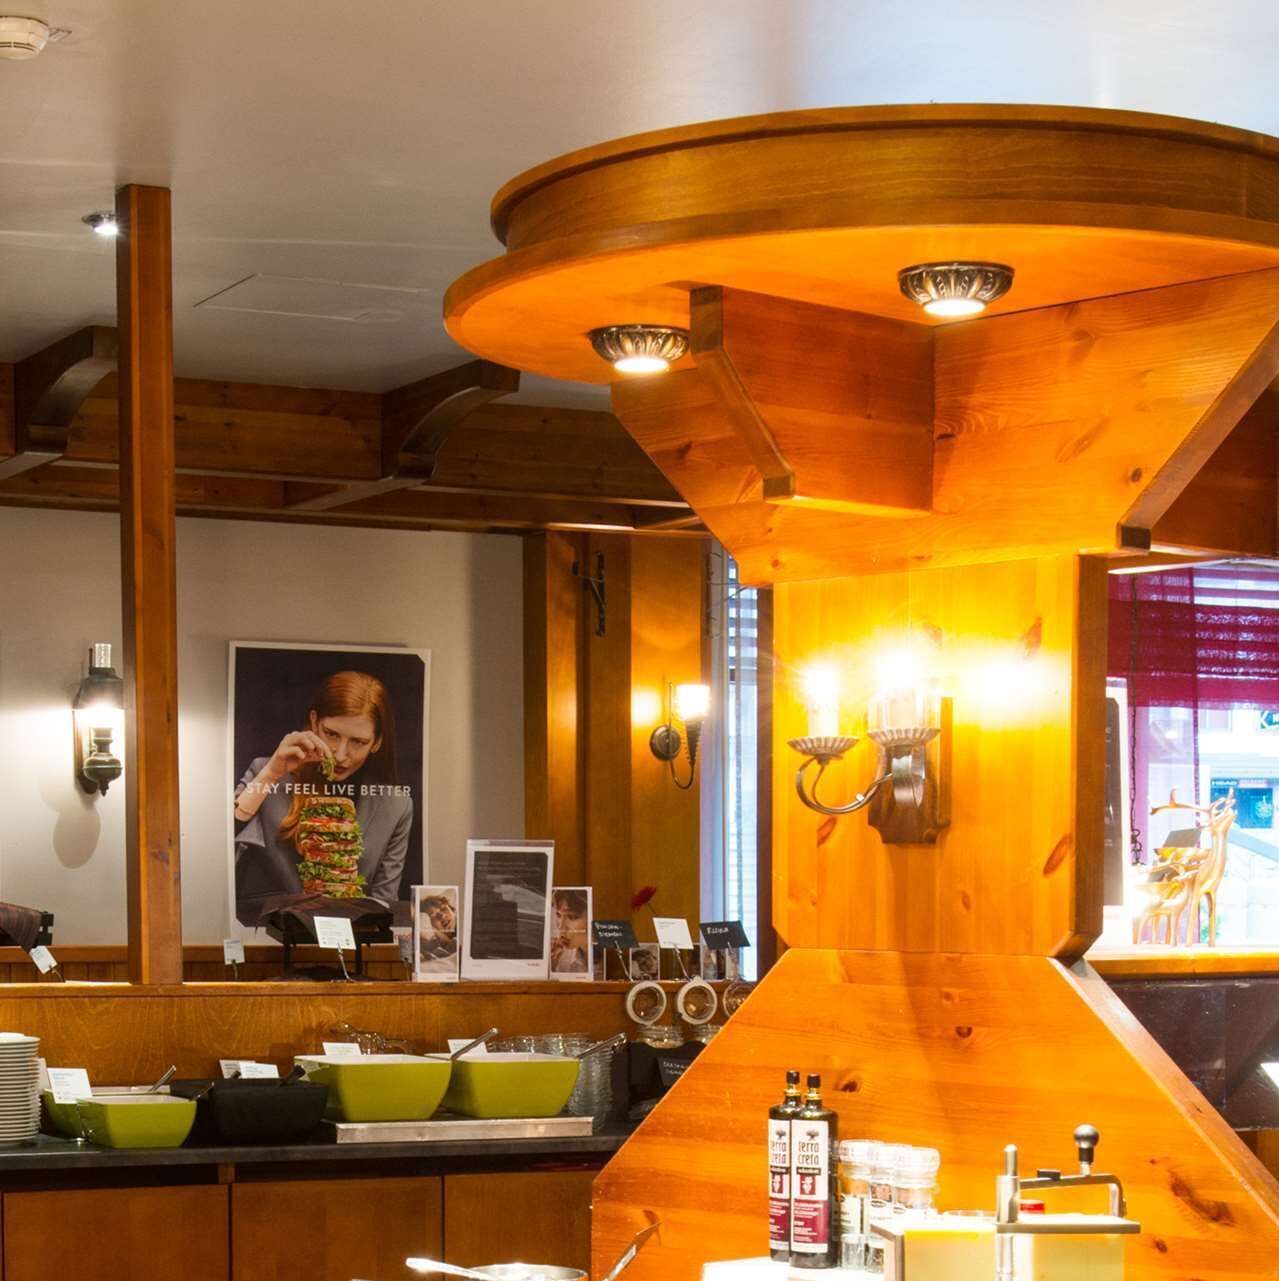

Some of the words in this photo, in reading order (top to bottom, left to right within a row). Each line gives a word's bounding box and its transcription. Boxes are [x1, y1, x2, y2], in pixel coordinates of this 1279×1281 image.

[246, 783, 280, 794] STAY
[285, 783, 319, 795] FEEL
[324, 784, 355, 795] LIVE
[361, 785, 412, 797] BETTER
